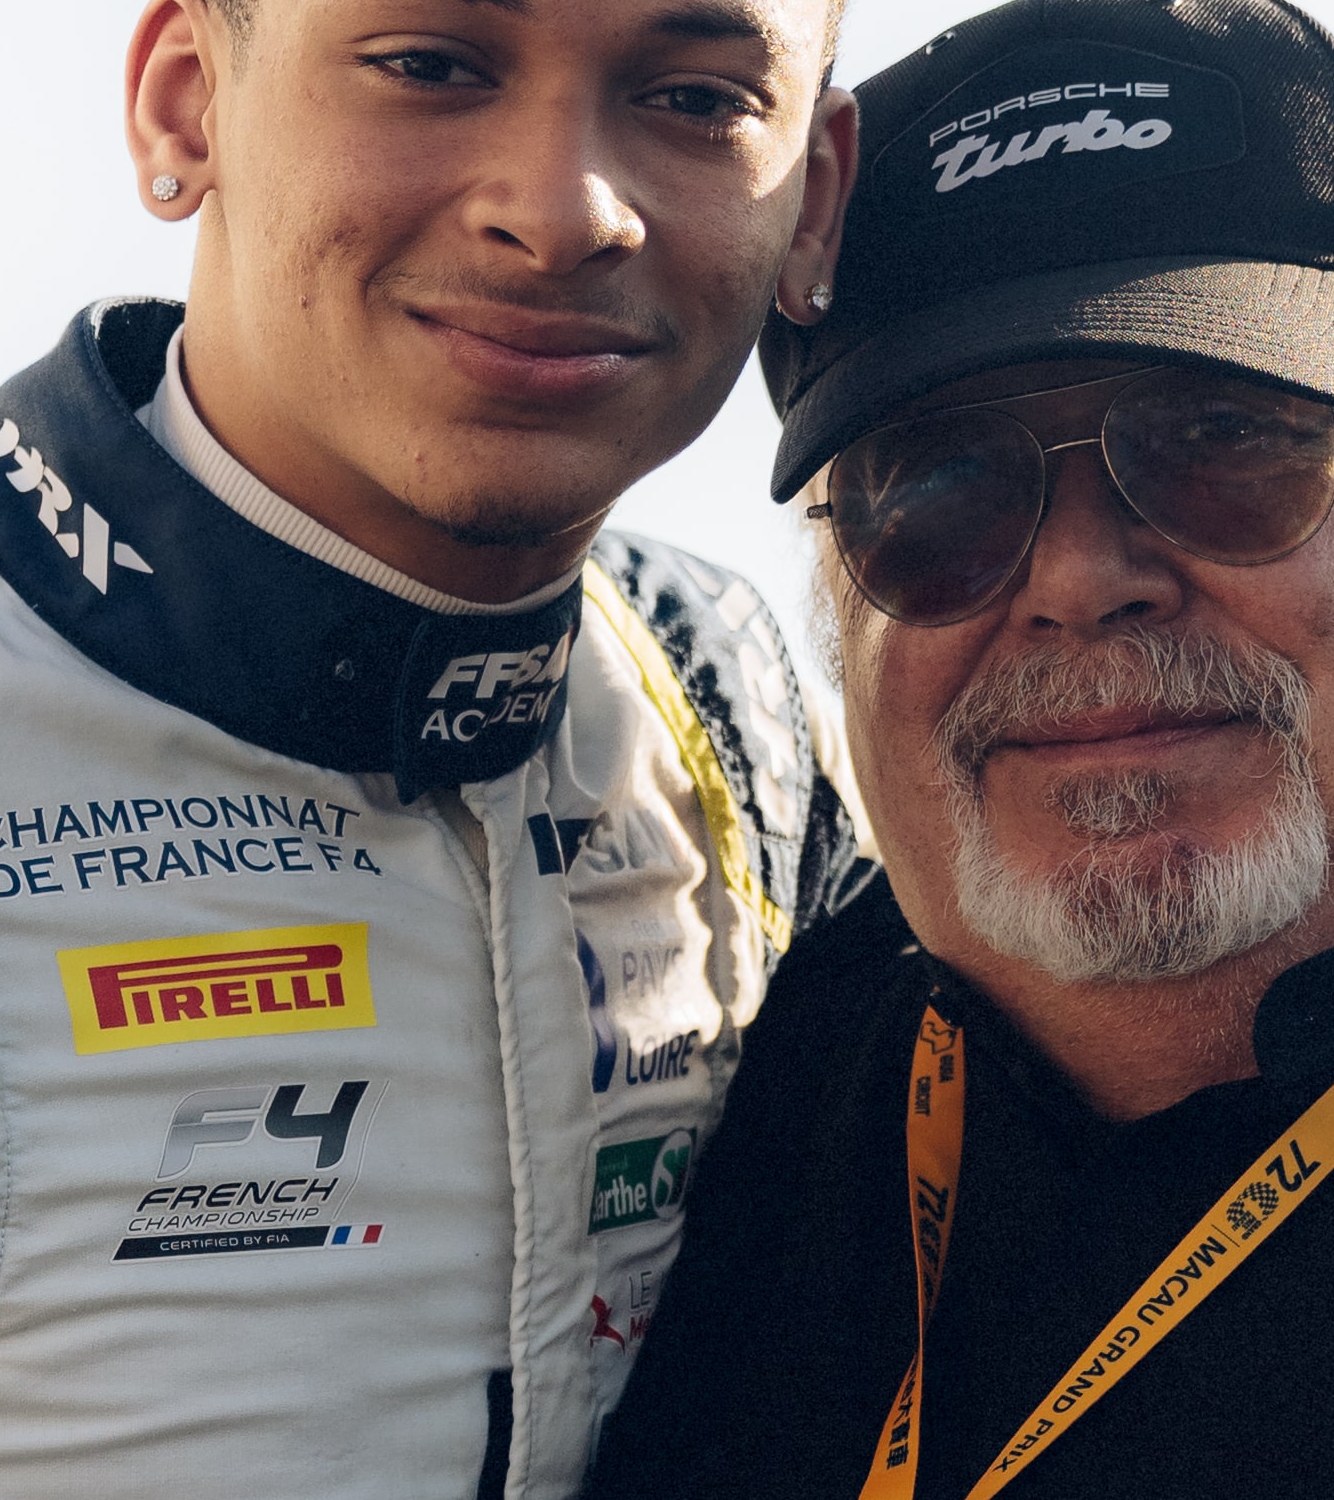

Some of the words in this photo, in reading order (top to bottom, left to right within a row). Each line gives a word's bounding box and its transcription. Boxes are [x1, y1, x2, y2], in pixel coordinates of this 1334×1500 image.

[929, 82, 1170, 148] PORSCHE
[931, 109, 1172, 193] turbo
[72, 836, 314, 891] FRANCE
[86, 943, 346, 1031] PIRELLI
[157, 1079, 370, 1180] F4
[136, 1177, 339, 1213] FRENCH
[1265, 1139, 1322, 1193] 72
[128, 1206, 320, 1233] CHAMPIONSHIP
[159, 1237, 240, 1252] CERTIFIED
[243, 1235, 263, 1247] BY
[267, 1233, 291, 1245] FIA
[1135, 1235, 1228, 1327] MACAU
[1052, 1325, 1142, 1414] GRAND
[991, 1418, 1055, 1473] PRIX
